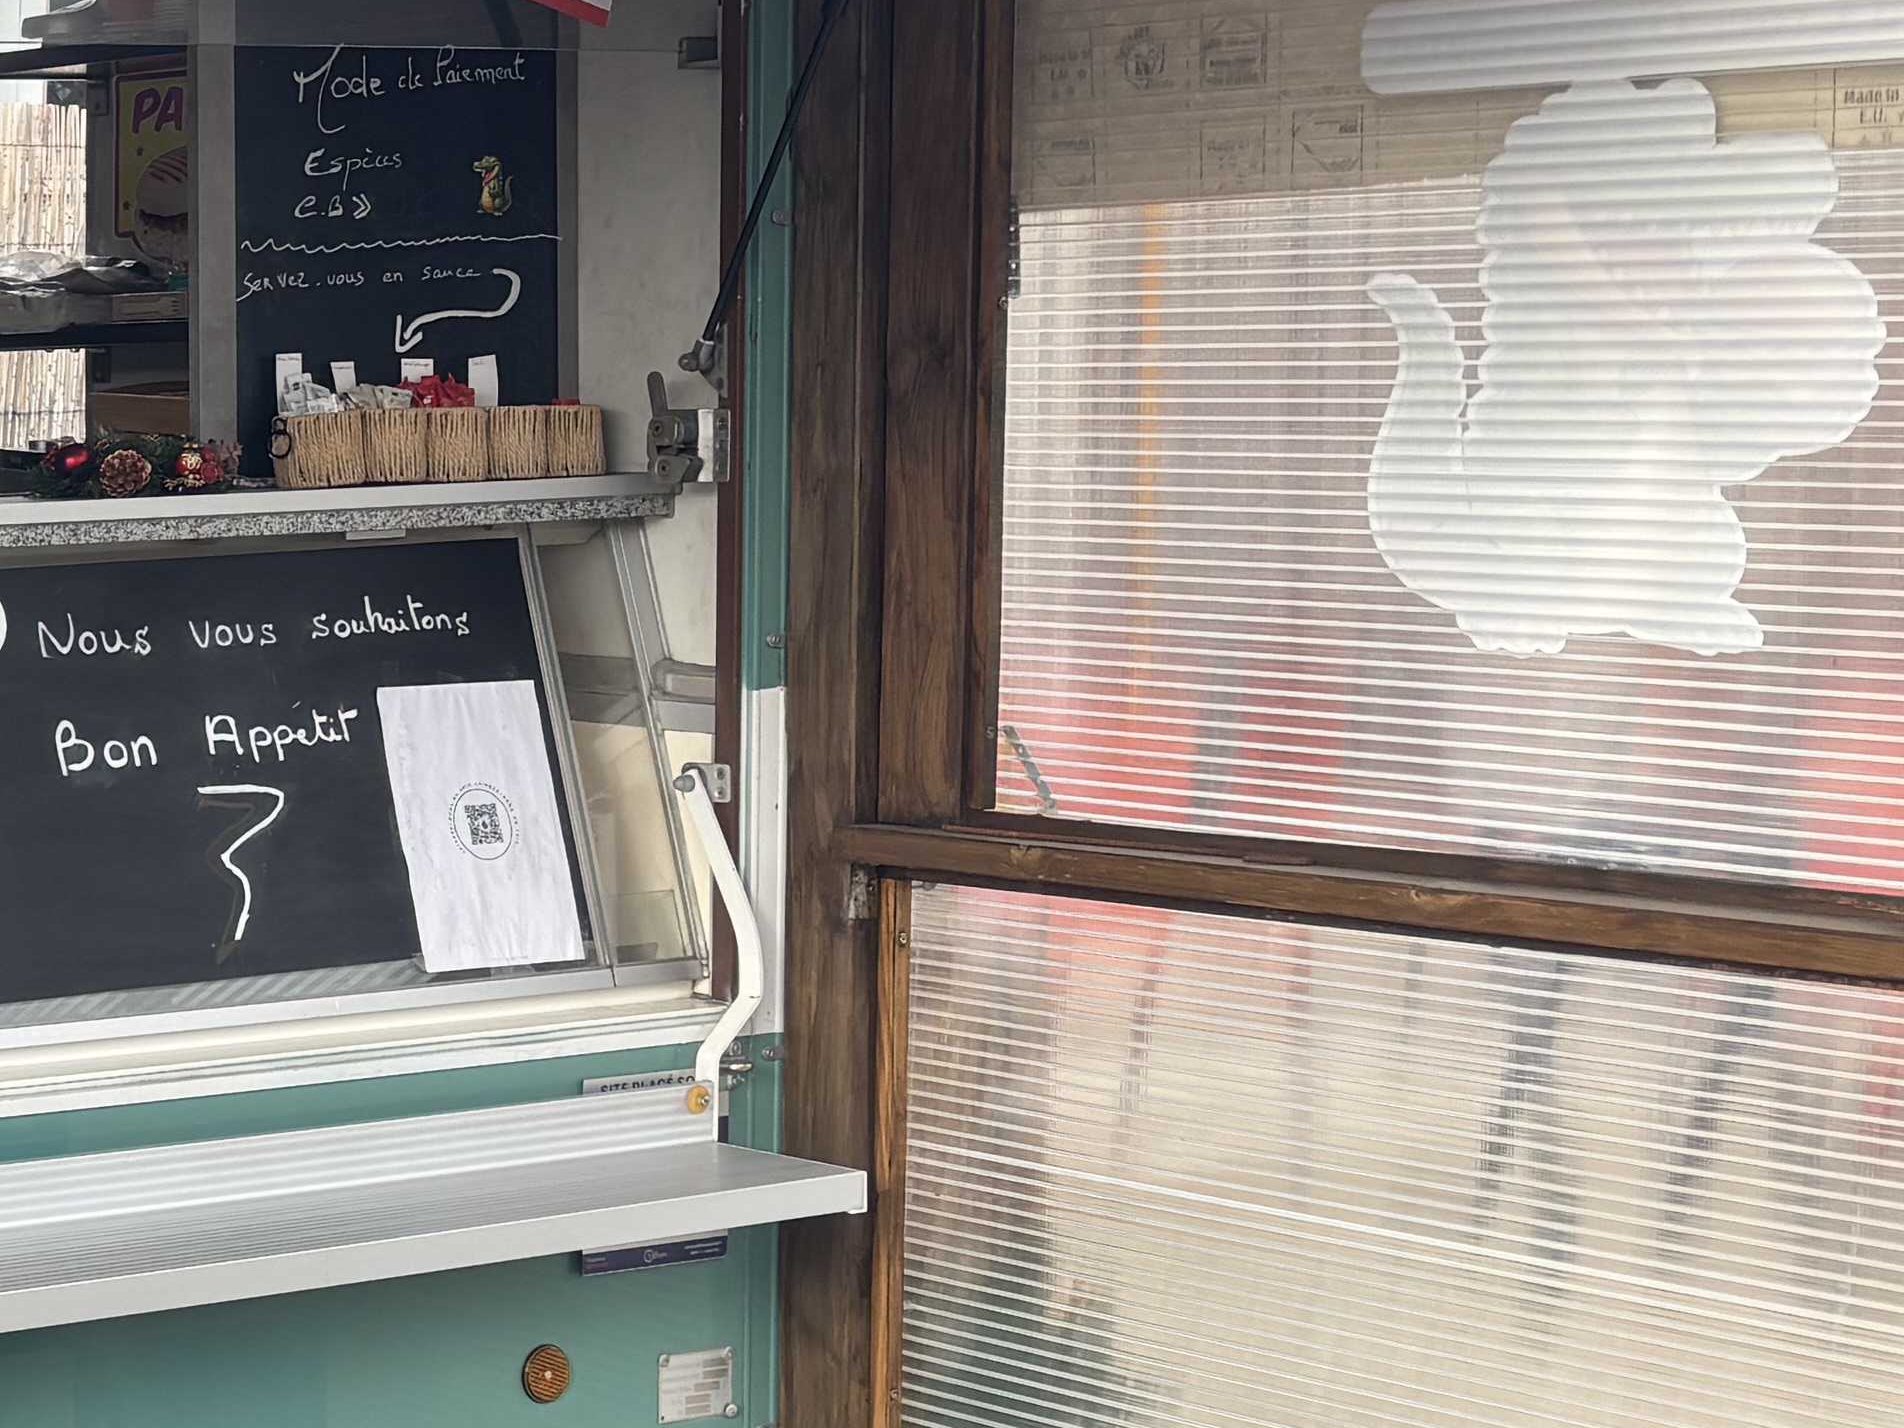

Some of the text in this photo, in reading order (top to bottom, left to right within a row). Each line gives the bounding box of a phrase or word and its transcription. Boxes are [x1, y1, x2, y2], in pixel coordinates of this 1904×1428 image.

[382, 272, 403, 283] en
[37, 611, 152, 660] Nous
[53, 717, 158, 777] Bon
